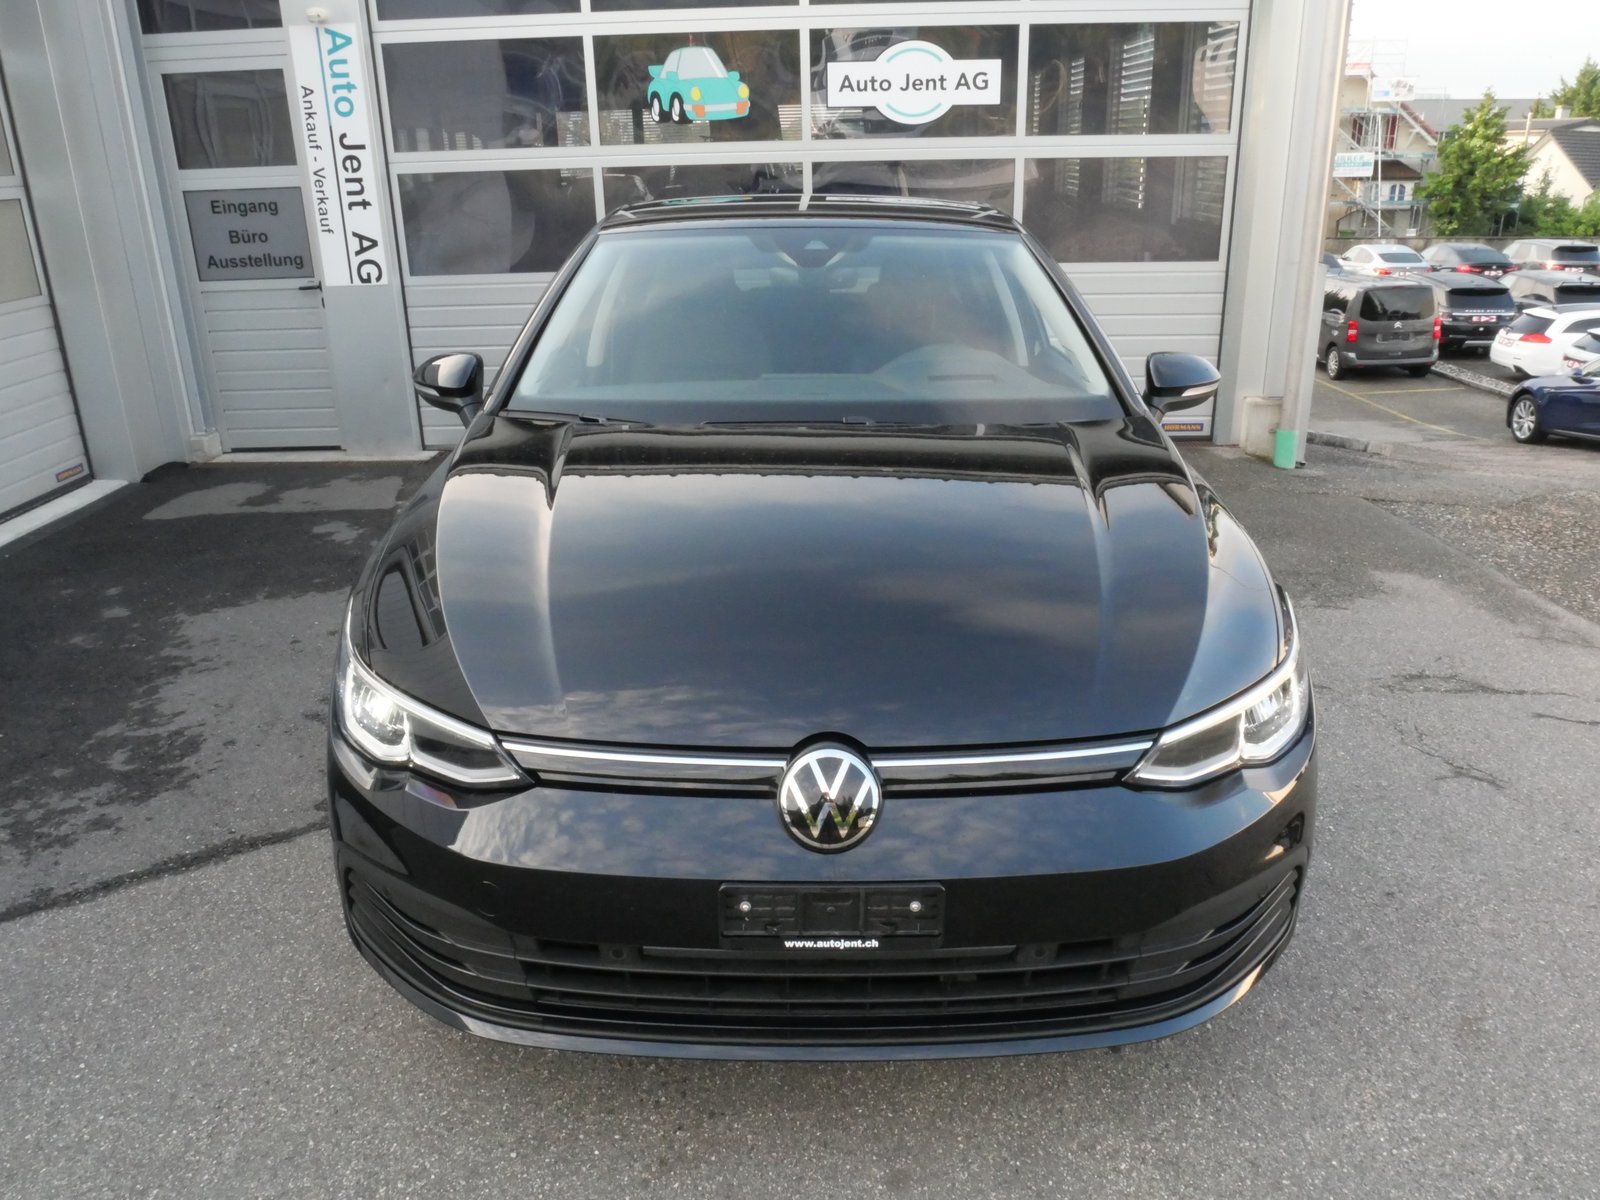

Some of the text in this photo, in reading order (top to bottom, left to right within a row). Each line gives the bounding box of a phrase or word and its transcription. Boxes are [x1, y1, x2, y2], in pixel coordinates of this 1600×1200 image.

[838, 71, 989, 92] Auto Jent AG
[300, 85, 323, 150] Ankauf
[312, 167, 334, 234] Verkauf
[324, 27, 383, 285] Auto Jent AG
[210, 200, 279, 217] Eingang
[228, 229, 268, 244] Büro
[207, 253, 304, 270] Ausstellung
[784, 938, 879, 950] www.autojent.ch
